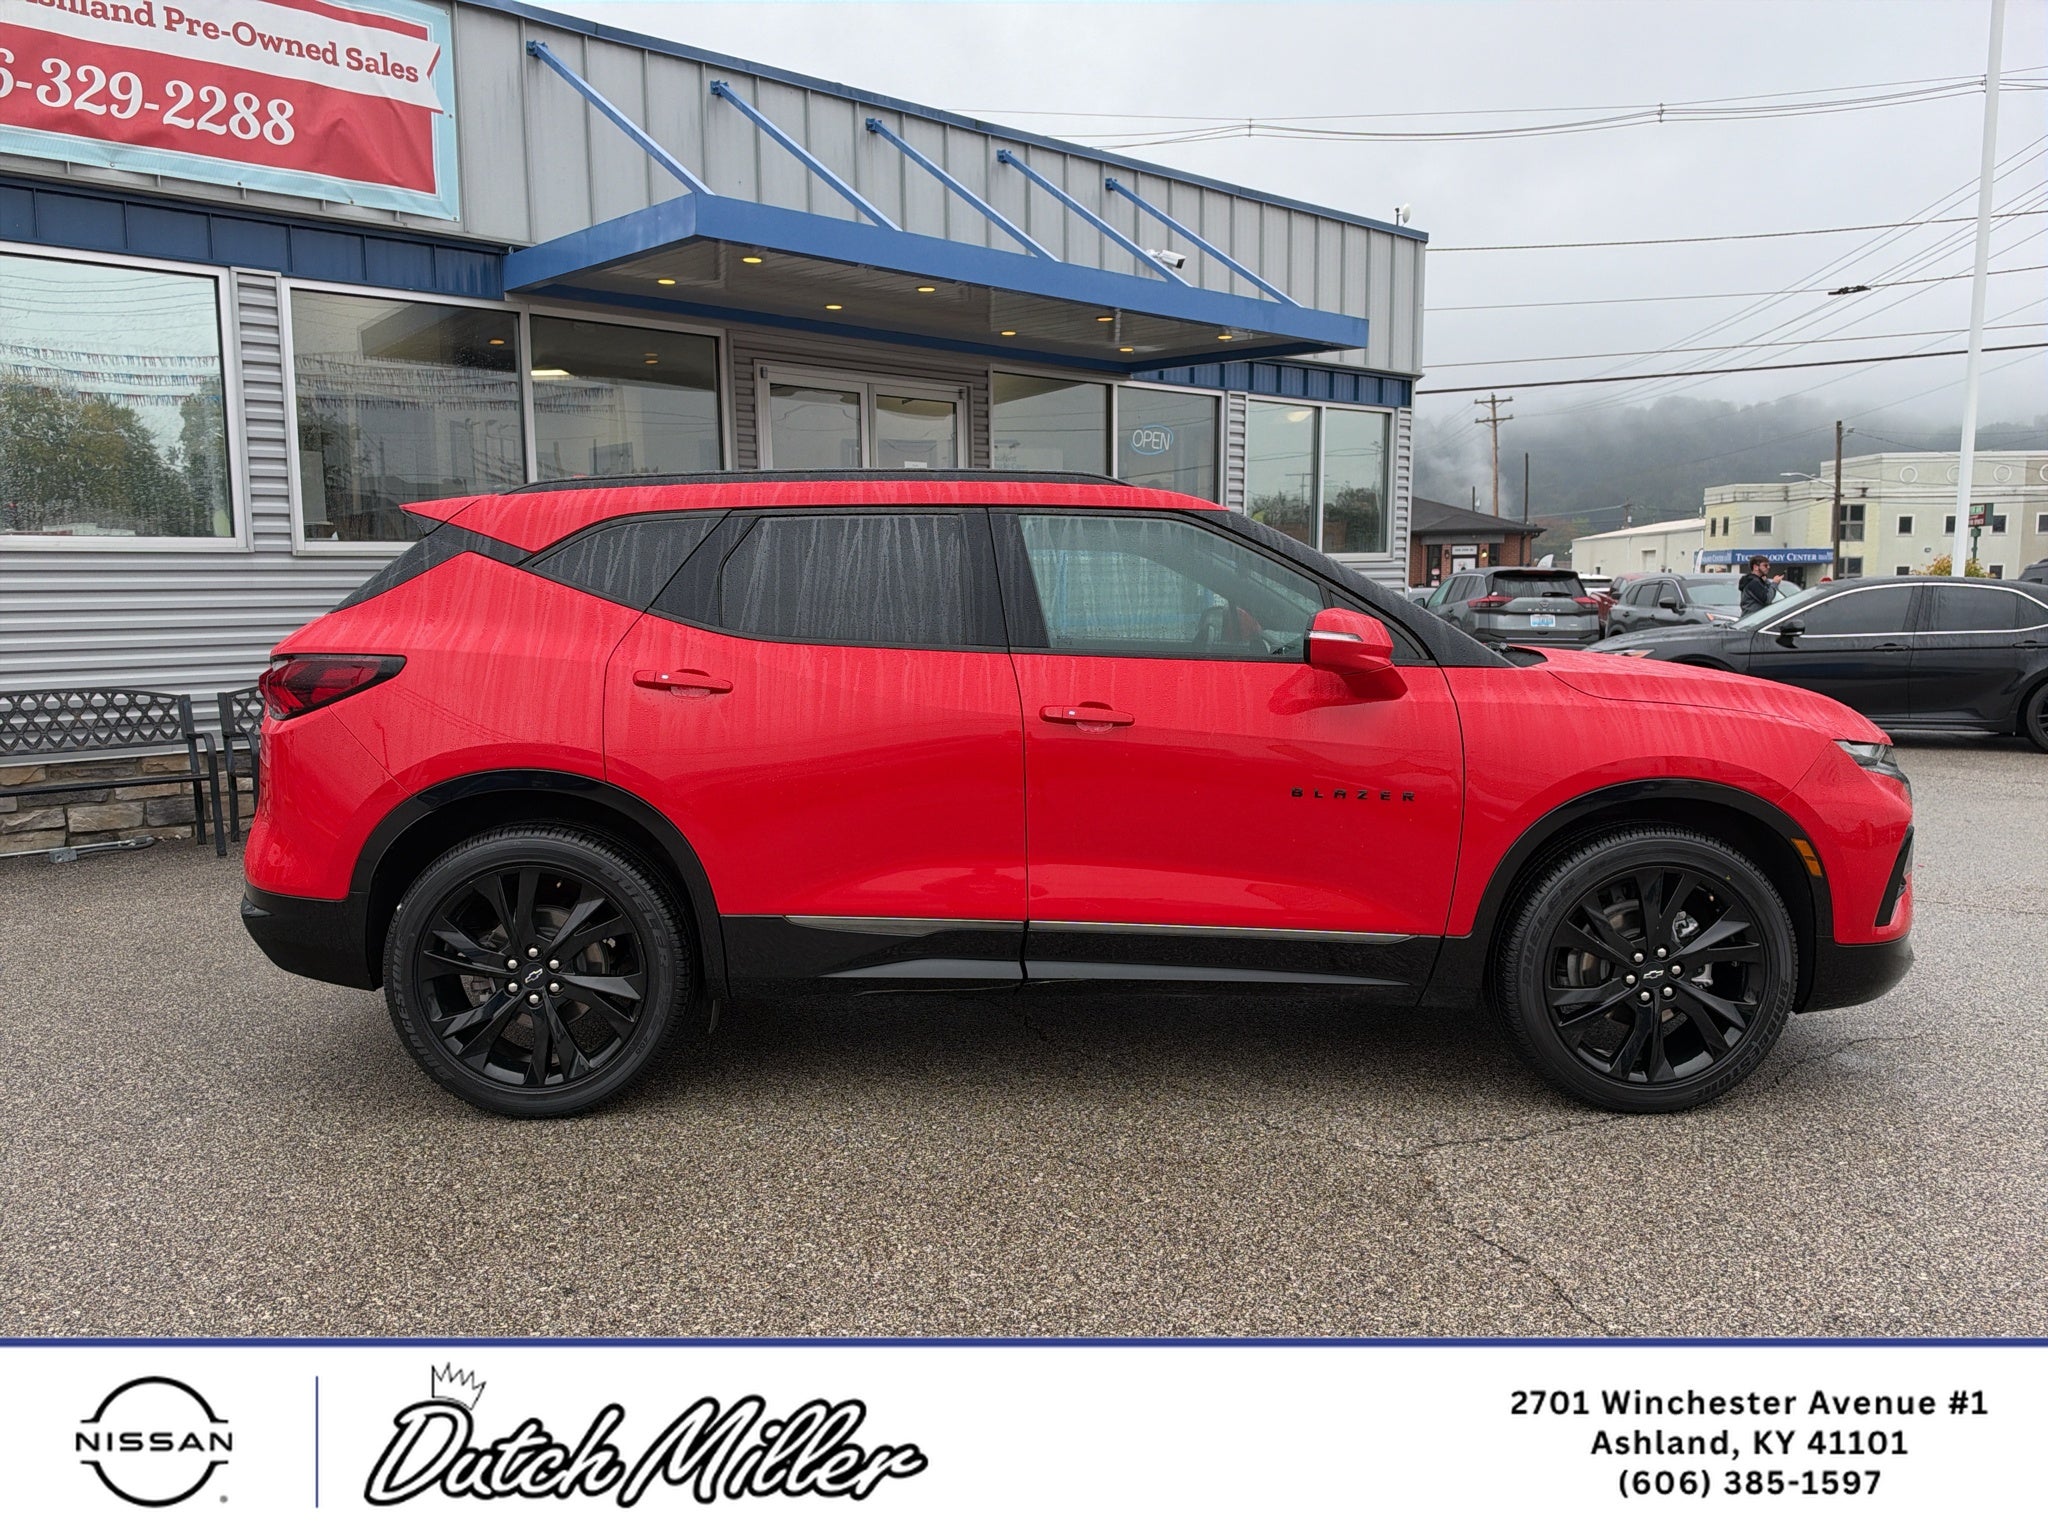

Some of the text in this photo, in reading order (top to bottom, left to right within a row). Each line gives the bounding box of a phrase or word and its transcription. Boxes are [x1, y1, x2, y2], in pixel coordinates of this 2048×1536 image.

[164, 4, 340, 67] Pre-Owned
[346, 47, 420, 83] Sales
[1132, 429, 1171, 451] OPEN
[1290, 786, 1416, 802] BLAZER
